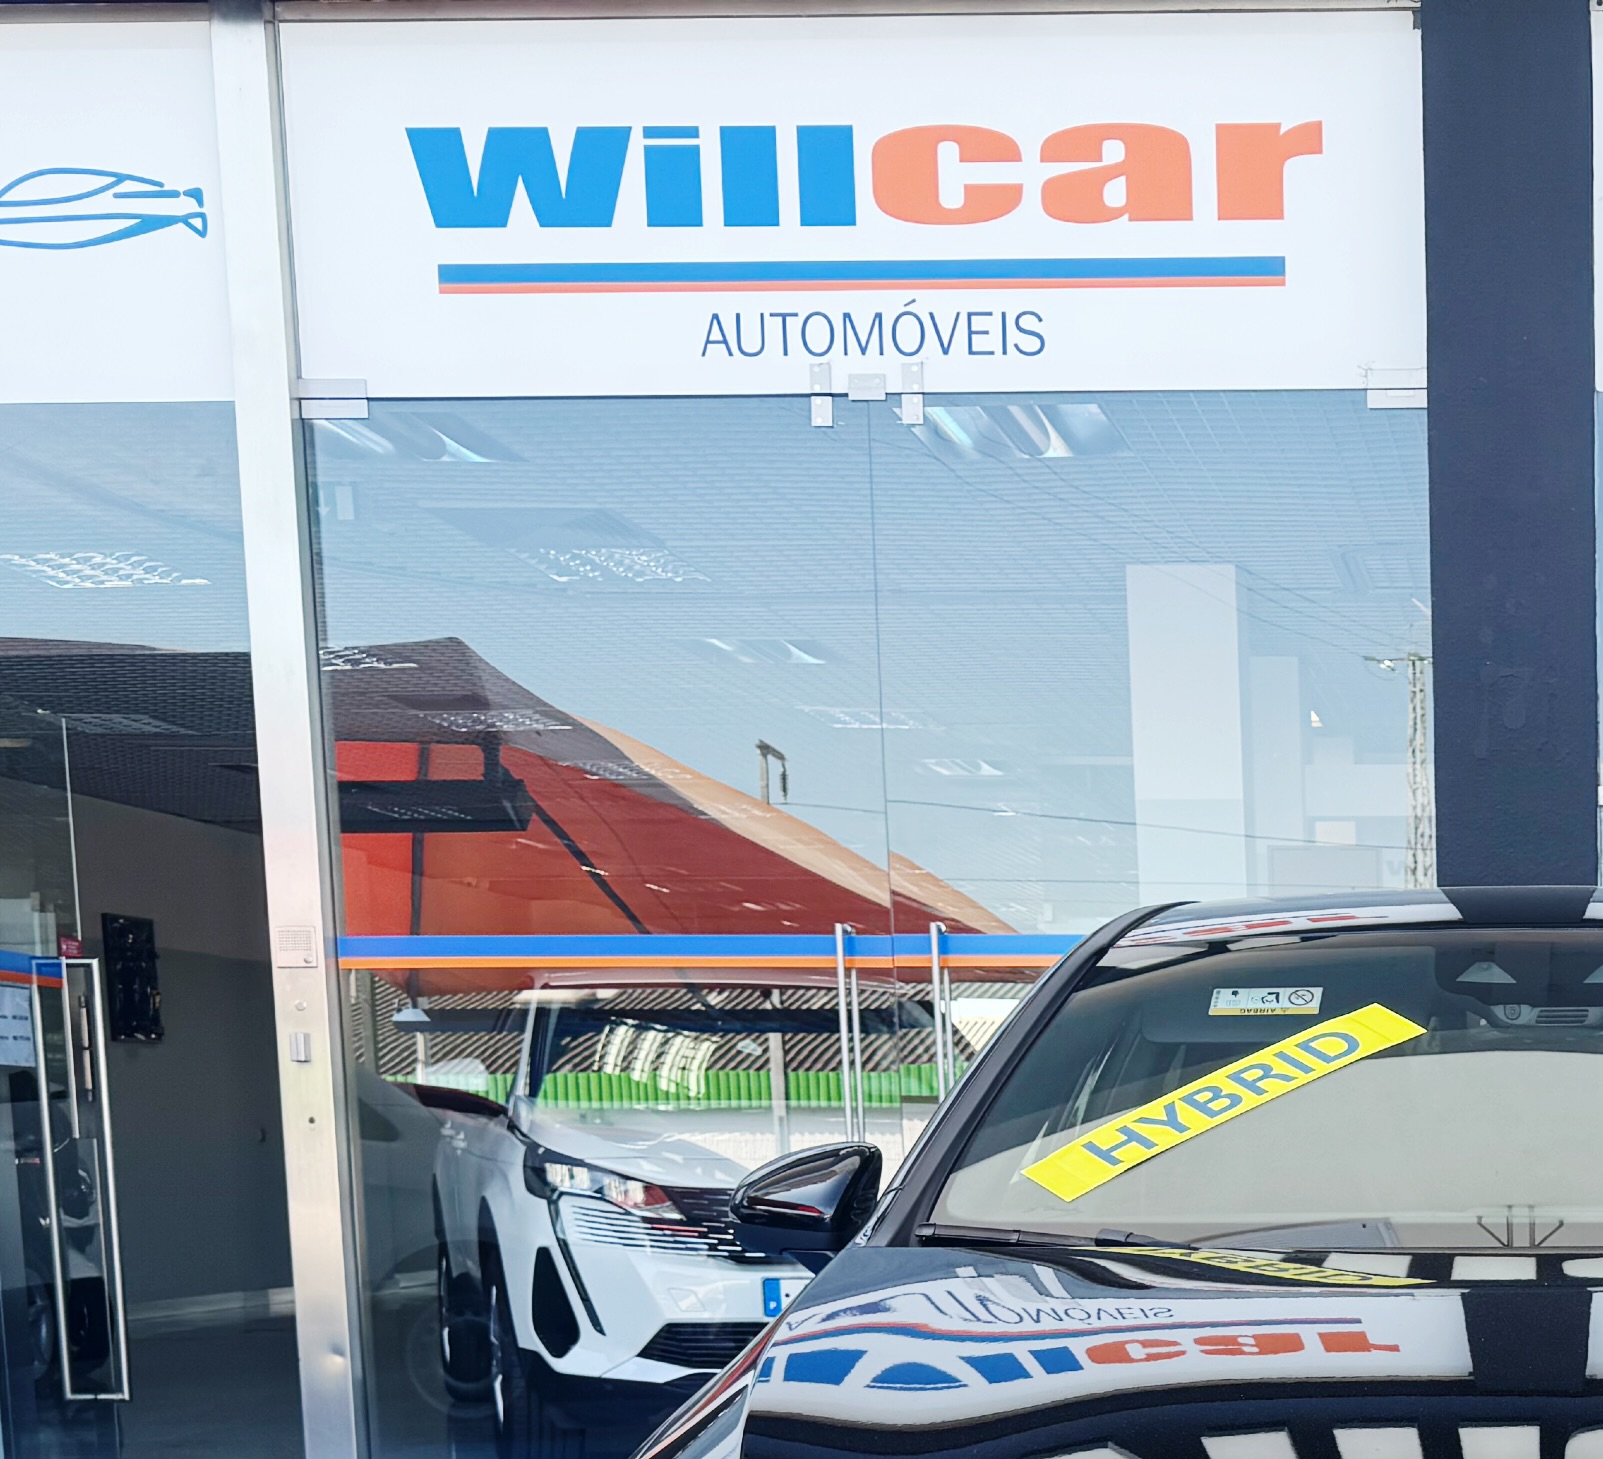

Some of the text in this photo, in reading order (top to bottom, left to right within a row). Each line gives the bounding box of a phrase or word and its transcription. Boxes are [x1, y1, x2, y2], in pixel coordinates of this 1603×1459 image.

[405, 119, 1324, 229] willcar
[701, 299, 1047, 358] AUTOMÓVEIS
[1082, 1031, 1361, 1166] HYBRID
